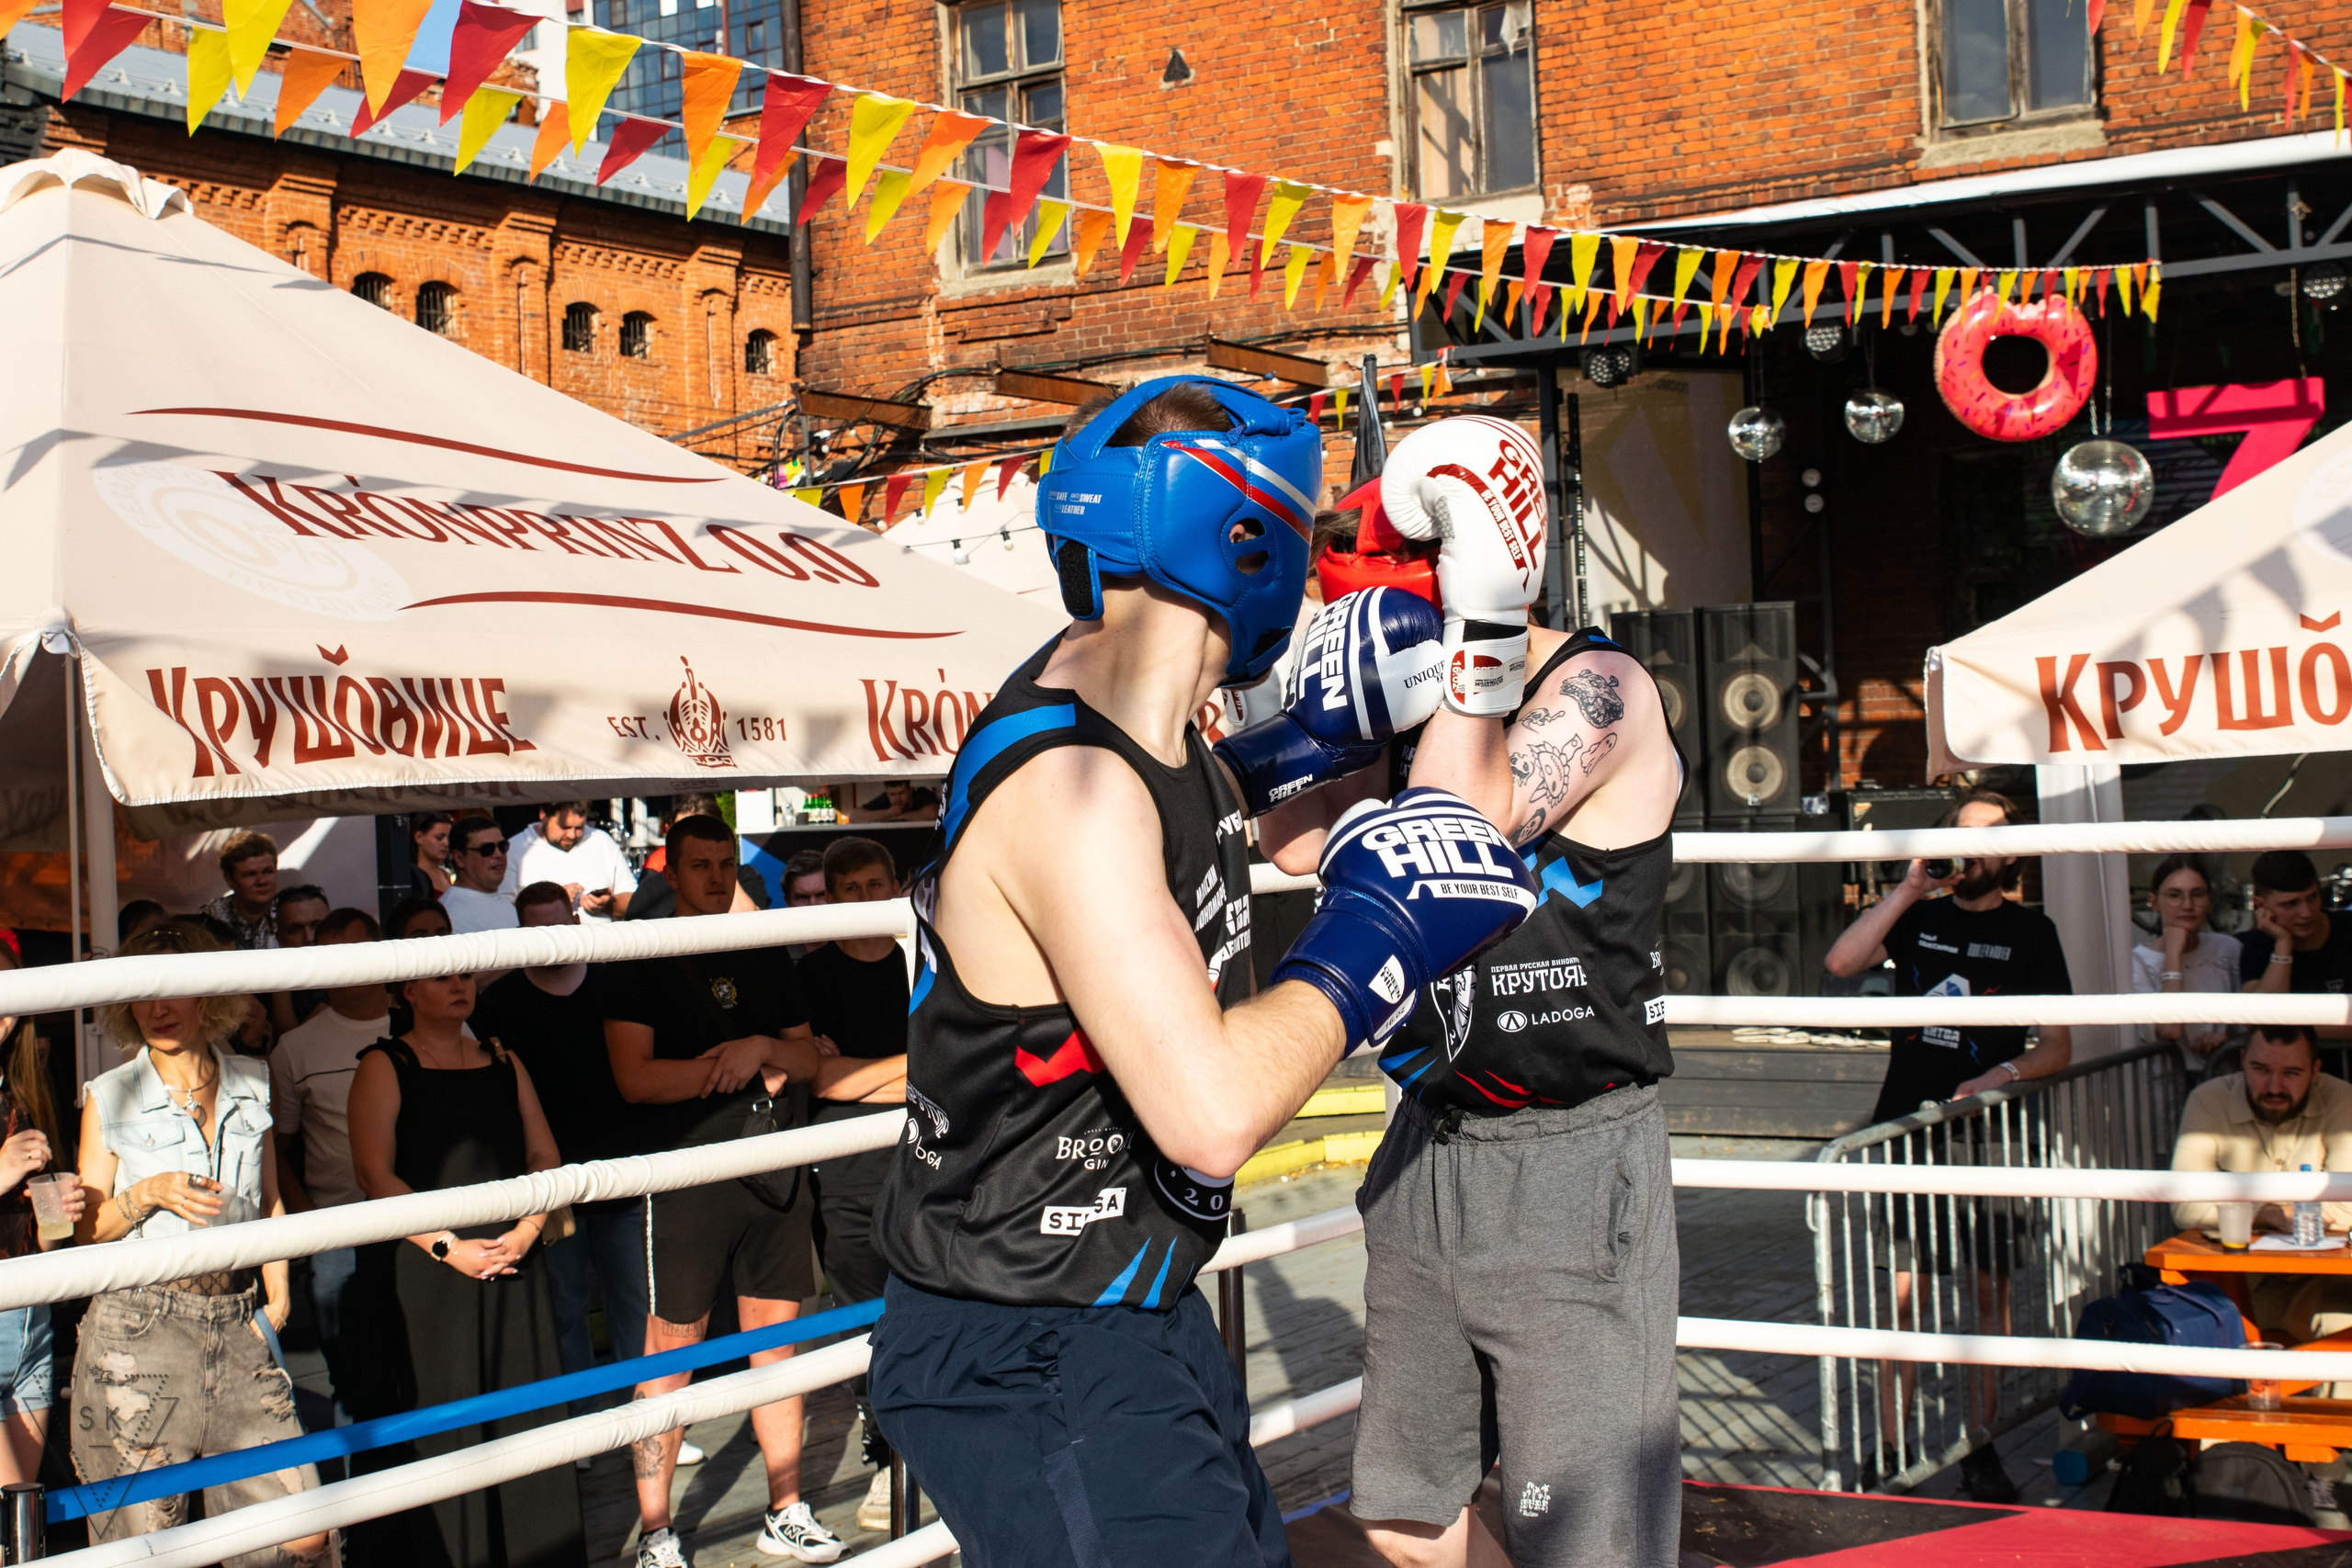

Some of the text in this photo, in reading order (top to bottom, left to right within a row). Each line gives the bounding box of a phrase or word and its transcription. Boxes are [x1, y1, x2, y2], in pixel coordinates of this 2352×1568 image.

[1061, 504, 1085, 515] LEATHER
[1079, 493, 1102, 504] SWEAT
[1480, 489, 1523, 561] BE YOUR BEST SELF
[1487, 457, 1542, 571] HILL
[1299, 600, 1340, 701] HILL
[1320, 591, 1359, 712] GREEN
[607, 716, 787, 741] EST. 1581
[1269, 773, 1313, 796] GREEN
[1270, 785, 1306, 803] HILL
[1362, 818, 1514, 852] GREEN
[1377, 840, 1514, 879] HILL
[1441, 883, 1520, 899] BE YOUR BEST SELF
[1490, 964, 1518, 974] ПЕРВАЯ
[1520, 960, 1550, 970] РУССКАЯ
[1380, 971, 1394, 1000] HILL
[1384, 966, 1401, 998] GREEN
[1532, 1006, 1595, 1025] LADOGA
[1084, 1157, 1110, 1170] GIN
